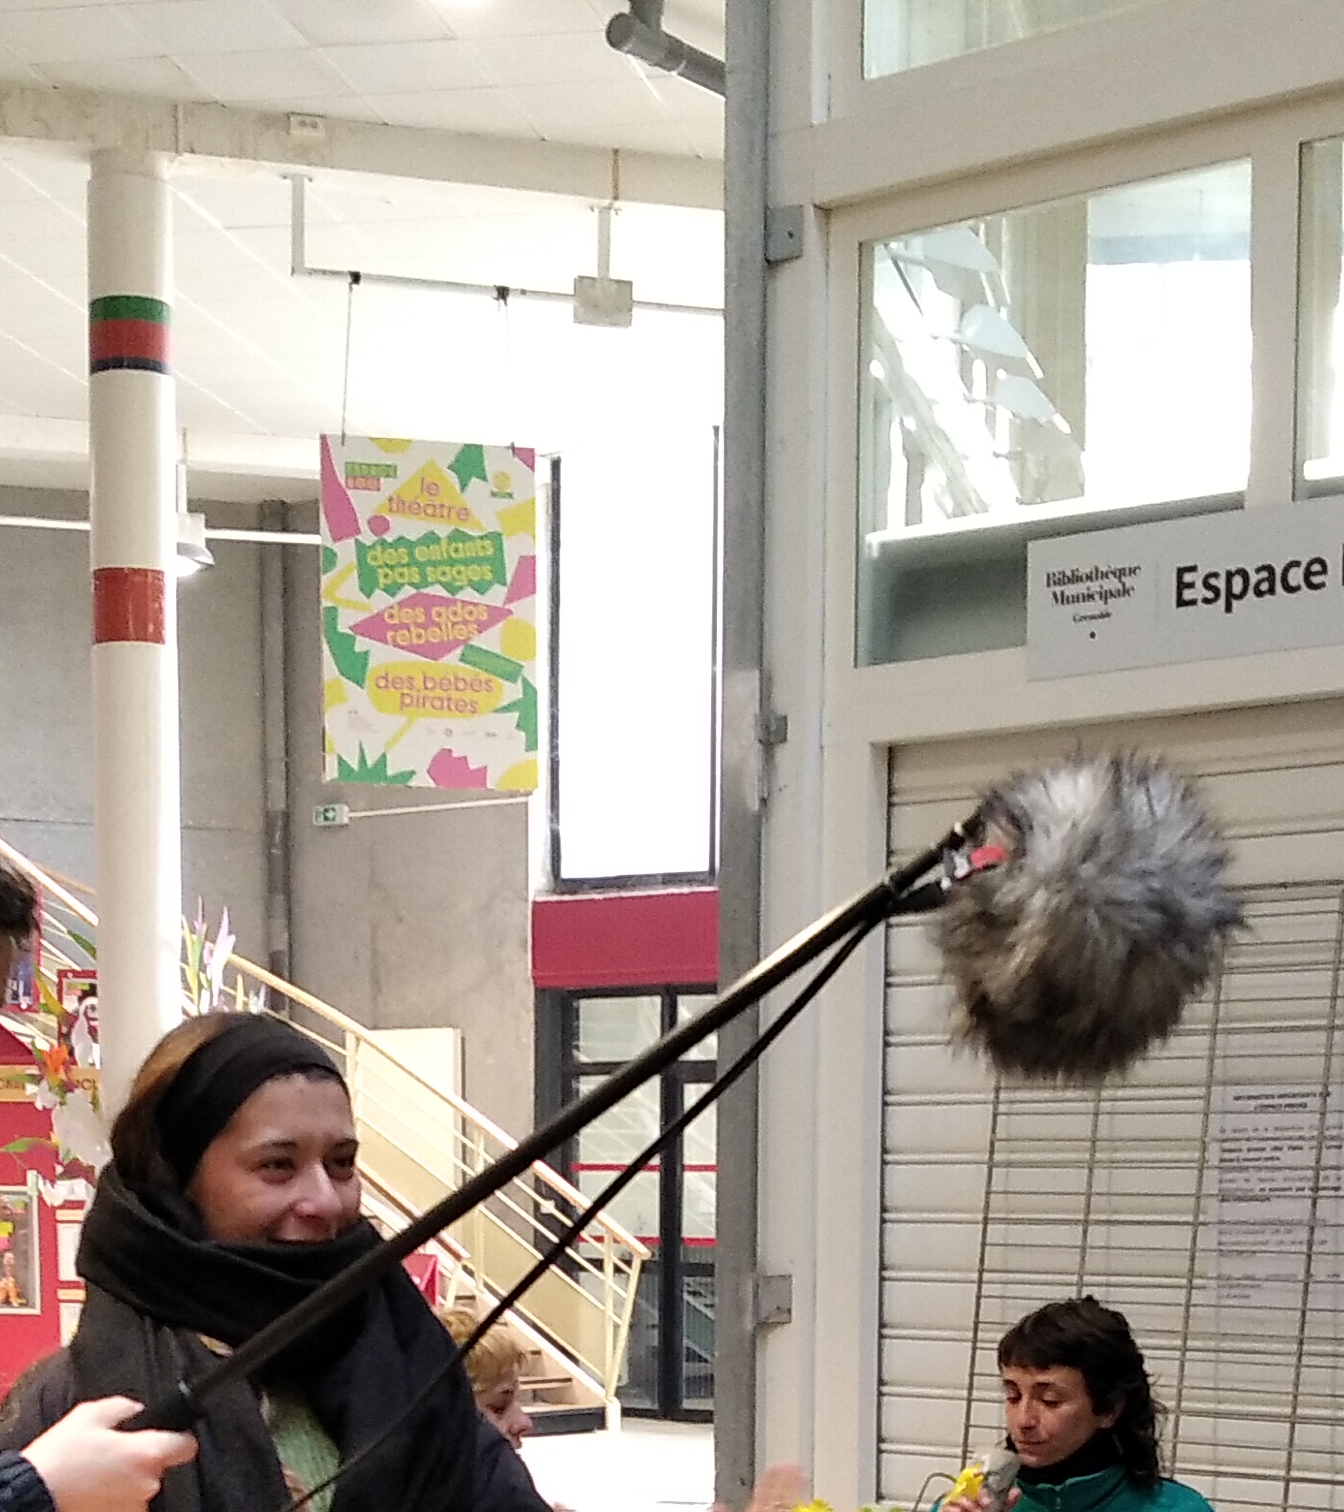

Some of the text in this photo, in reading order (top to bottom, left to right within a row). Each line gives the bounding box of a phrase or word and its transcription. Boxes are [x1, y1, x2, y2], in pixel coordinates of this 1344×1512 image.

[420, 477, 440, 497] le
[387, 492, 470, 522] théâtre
[367, 538, 494, 566] des enfants
[377, 563, 493, 588] pas sages
[1045, 565, 1142, 588] Bibliothèque
[1175, 556, 1329, 613] Espace
[1052, 581, 1136, 606] Municipale
[384, 602, 488, 626] des ados
[387, 622, 478, 646] rebelles
[374, 670, 494, 693] des bébés
[400, 692, 478, 714] pirates
